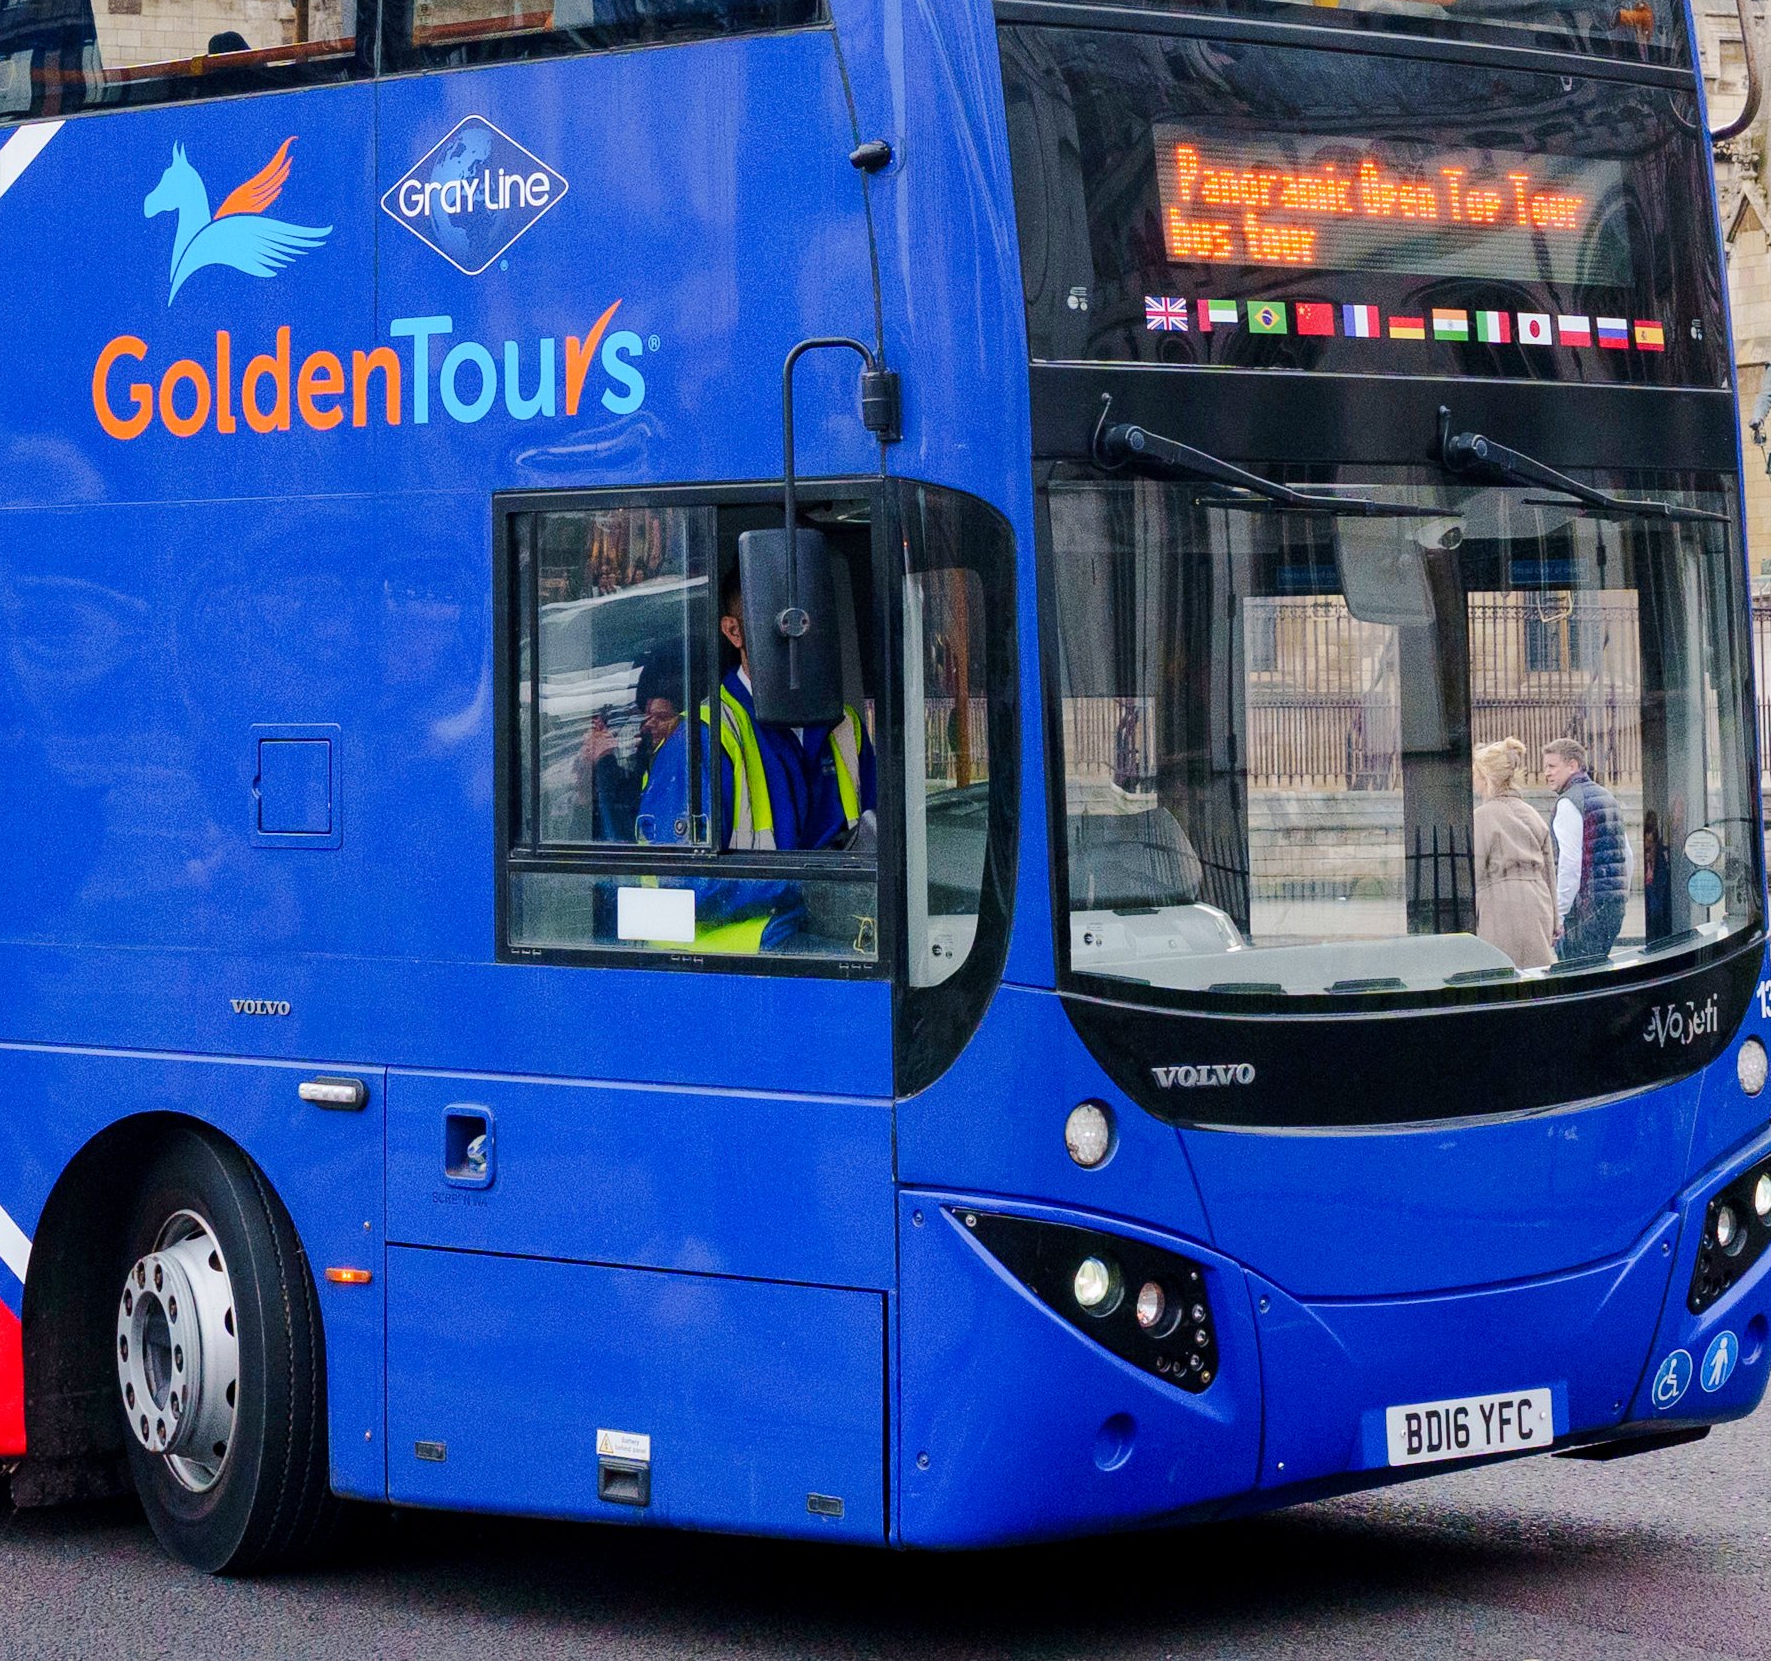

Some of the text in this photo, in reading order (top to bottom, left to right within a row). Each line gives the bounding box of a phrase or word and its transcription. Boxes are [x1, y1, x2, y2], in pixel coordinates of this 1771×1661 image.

[399, 167, 551, 217] Gray Line
[1175, 146, 1583, 228] Panoramic Open Top Tour
[1169, 207, 1318, 263] bus tour
[230, 999, 291, 1016] VOLVO
[1151, 1063, 1256, 1089] VOLVO
[1405, 1398, 1534, 1456] BD16 YFC
